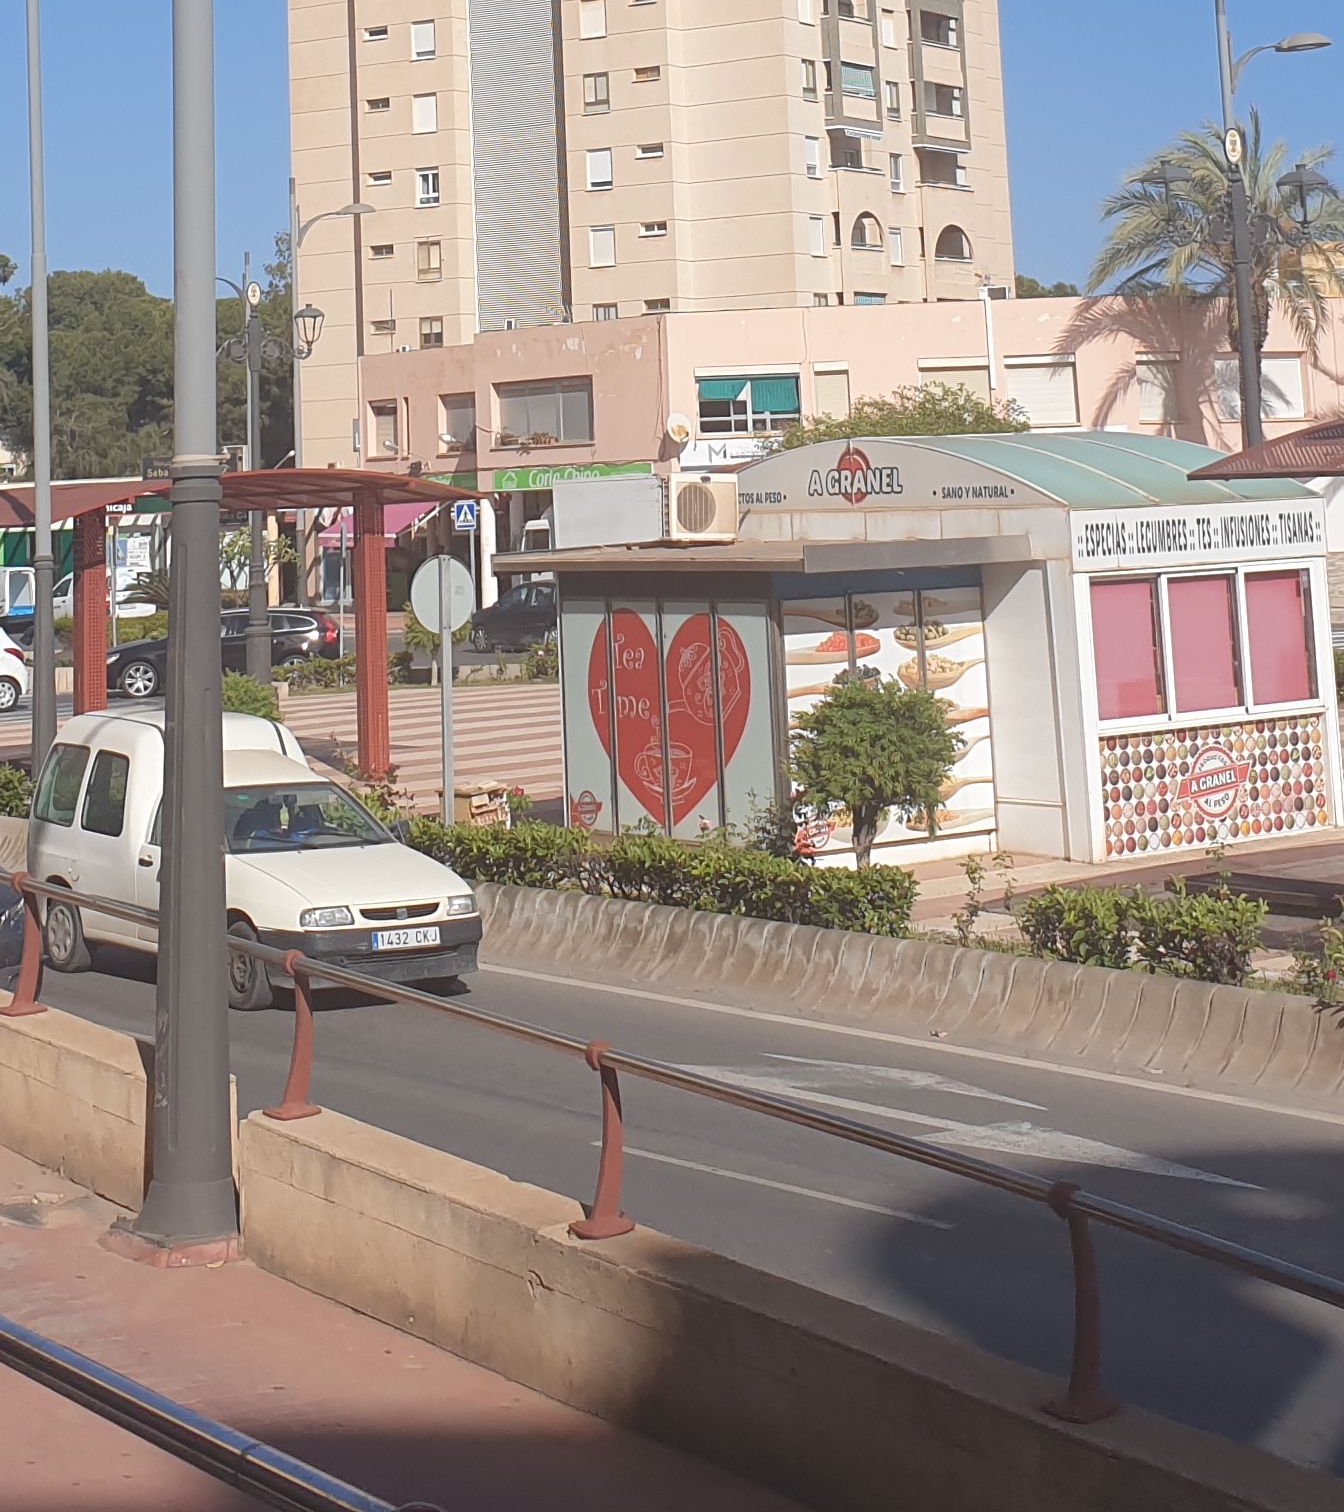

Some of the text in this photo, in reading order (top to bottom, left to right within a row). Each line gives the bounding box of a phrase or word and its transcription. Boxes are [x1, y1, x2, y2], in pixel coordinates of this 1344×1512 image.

[808, 466, 904, 496] A GRANEL
[756, 492, 764, 504] AL
[765, 492, 782, 504] PESO
[942, 485, 1009, 500] SANO Y NATURAL
[1085, 511, 1314, 557] ESPECIAS LEGUMBRES TES INFUSIONES TISANAS
[592, 679, 650, 719] Tme
[1191, 769, 1236, 793] A GRANEL
[1213, 792, 1230, 808] PESO
[380, 929, 437, 947] 1432 CKJ
